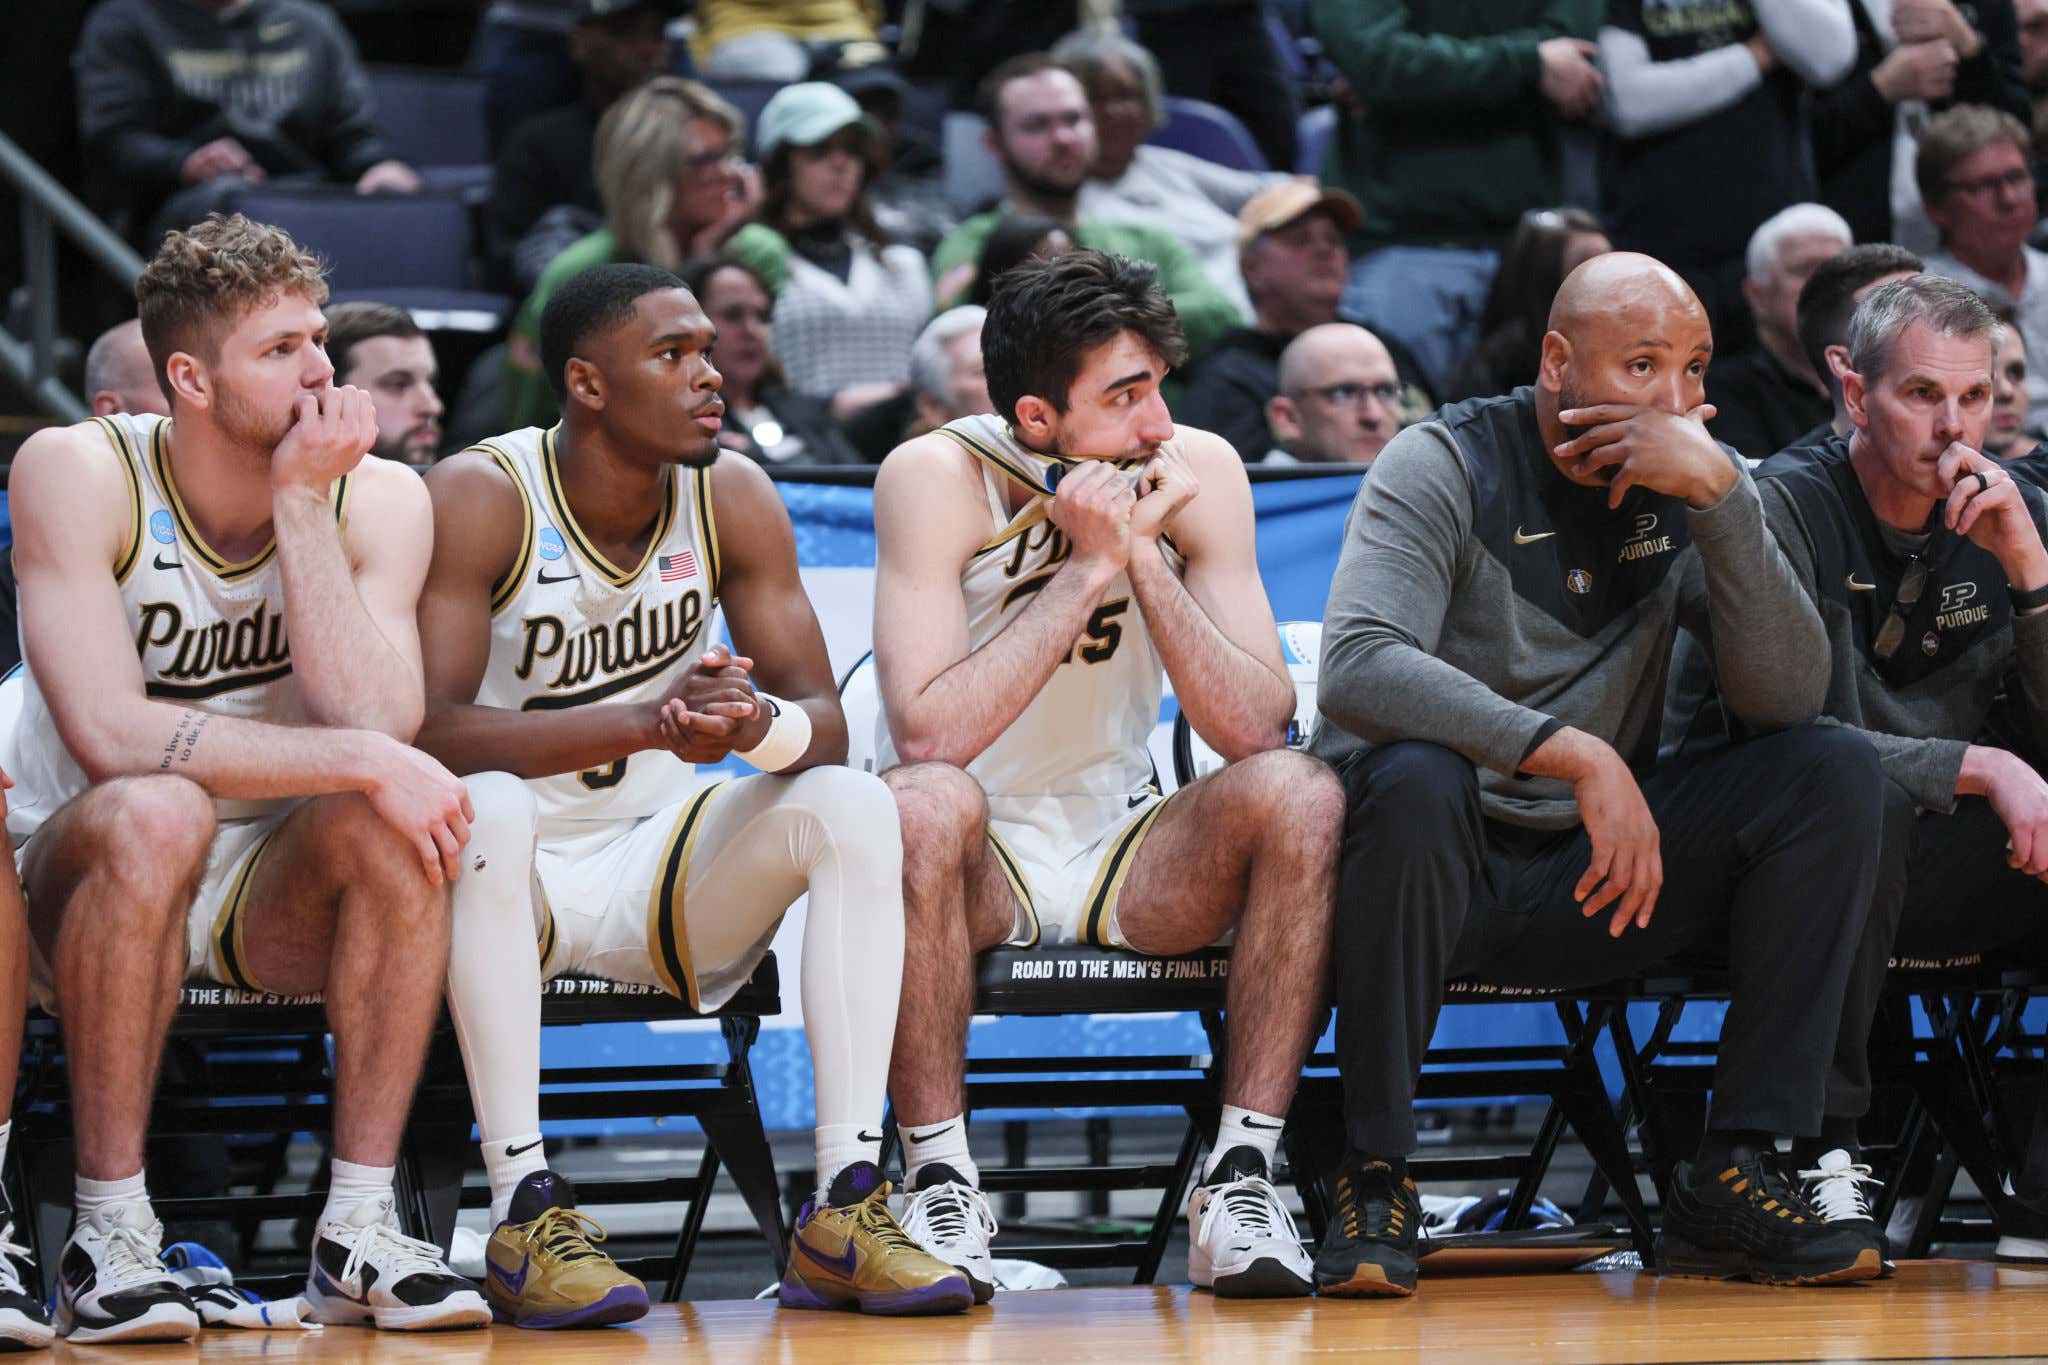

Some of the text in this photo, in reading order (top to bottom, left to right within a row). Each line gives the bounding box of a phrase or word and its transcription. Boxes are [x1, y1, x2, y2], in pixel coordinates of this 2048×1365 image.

[1935, 604, 1988, 631] PURDUE
[514, 588, 703, 690] Purdue
[165, 731, 183, 752] live
[1012, 960, 1053, 979] ROAD
[1058, 960, 1077, 979] TO
[1080, 960, 1109, 979] THE
[1112, 960, 1161, 979] MEN'S
[1165, 959, 1206, 979] FINAL
[189, 988, 221, 1005] THE
[554, 979, 576, 994] TO
[579, 980, 610, 994] THE
